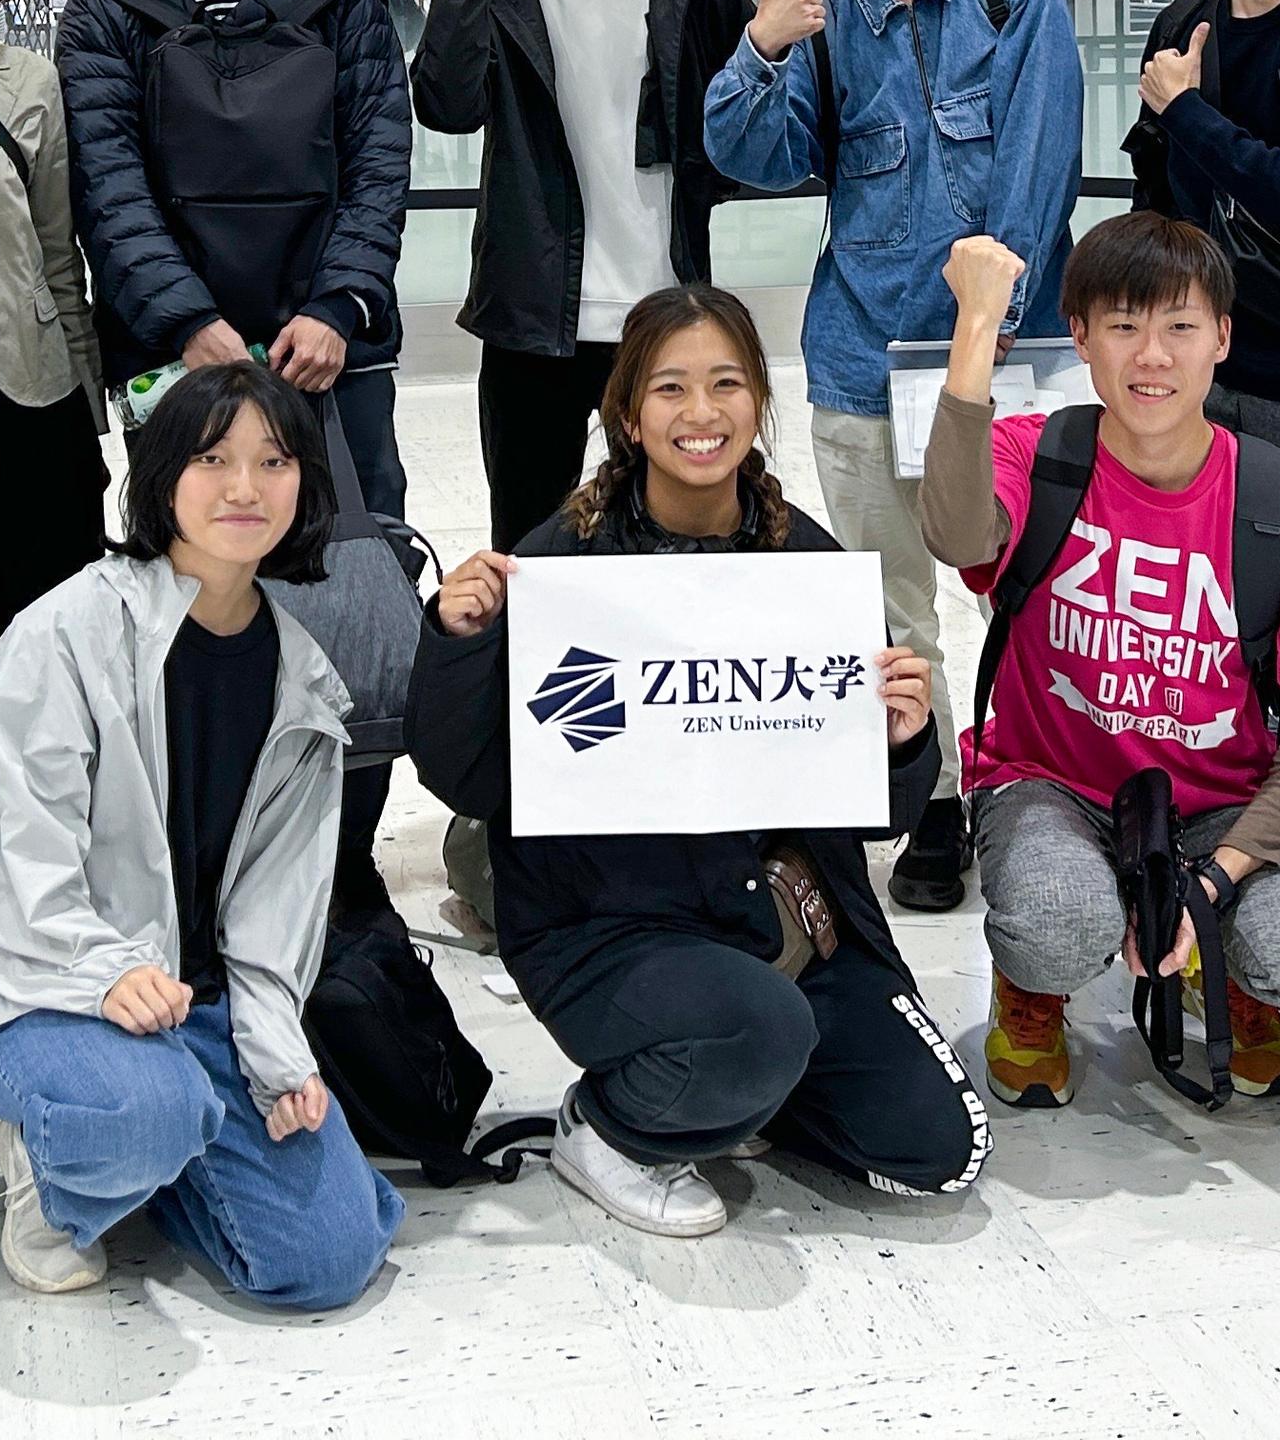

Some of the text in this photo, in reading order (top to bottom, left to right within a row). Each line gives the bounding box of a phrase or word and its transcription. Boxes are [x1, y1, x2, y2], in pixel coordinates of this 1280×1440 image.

[1051, 517, 1239, 639] ZEN
[1049, 598, 1236, 689] UNIVERSITY
[641, 654, 866, 707] ZEN大学
[1098, 671, 1156, 708] DAY
[683, 714, 826, 734] ZEN University
[1085, 702, 1201, 746] ANNIVERSARY
[892, 994, 965, 1083] scuba
